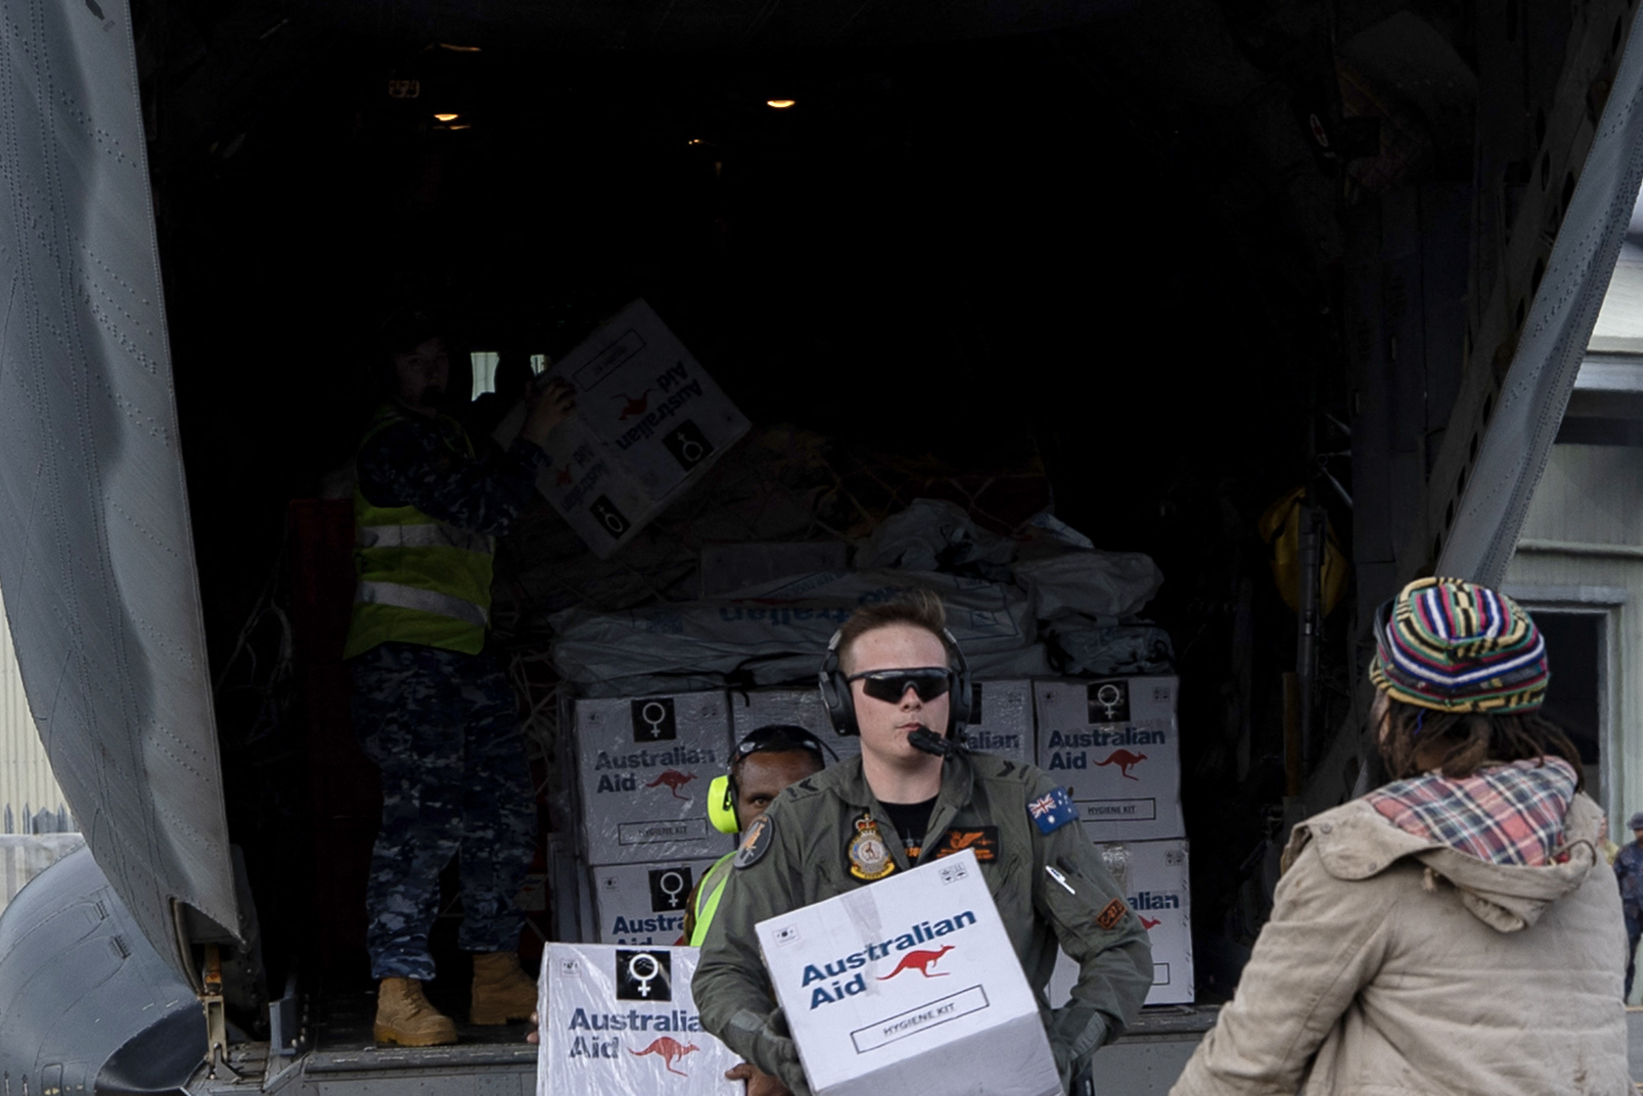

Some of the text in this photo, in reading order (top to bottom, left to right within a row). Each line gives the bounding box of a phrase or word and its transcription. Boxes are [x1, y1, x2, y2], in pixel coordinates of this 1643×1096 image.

[719, 607, 850, 626] tralian
[967, 731, 1019, 750] alian
[1048, 728, 1166, 750] Australian
[1048, 752, 1087, 771] Aid
[597, 773, 637, 794] Aid
[1088, 805, 1136, 816] HYGIENE KIT
[1127, 891, 1180, 911] alian
[612, 914, 685, 935] Austra
[801, 909, 978, 988] Australian
[809, 973, 867, 1010] Aid
[568, 1008, 706, 1032] Australia
[883, 1003, 956, 1037] HYGIENE KIT
[568, 1035, 620, 1059] Aid
